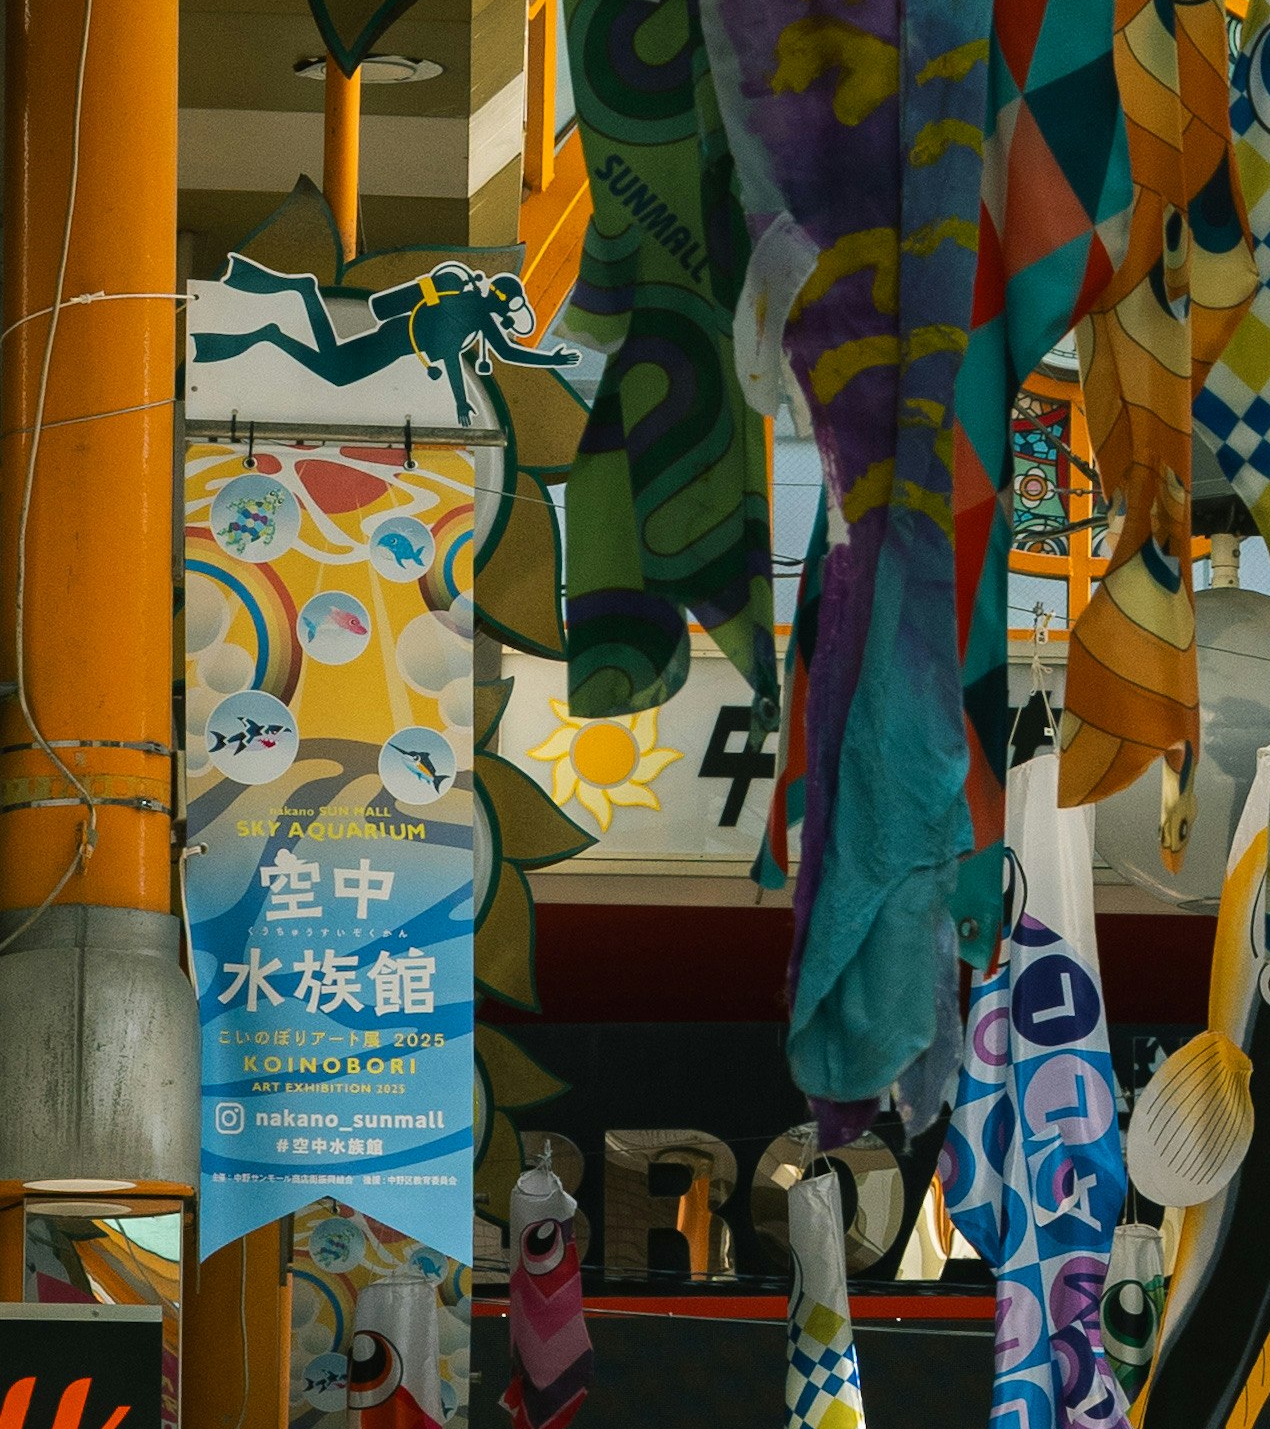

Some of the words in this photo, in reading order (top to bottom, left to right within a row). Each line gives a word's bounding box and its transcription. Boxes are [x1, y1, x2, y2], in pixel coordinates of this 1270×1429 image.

[595, 153, 709, 284] SUNMALL
[269, 806, 315, 817] nakano
[319, 806, 349, 817] SUN
[353, 806, 392, 818] MALL
[236, 820, 281, 837] SKY
[287, 821, 427, 842] AQUARIUM
[259, 849, 396, 921] 空中
[248, 927, 408, 938] くうちゅうすいぞくかん
[217, 947, 437, 1017] 水族館
[218, 1030, 381, 1048] こいのぼりアート展
[394, 1033, 446, 1048] 2025
[243, 1056, 417, 1075] KOINOBORI
[252, 1082, 280, 1093] ART
[285, 1082, 372, 1094] EXHIBITION
[376, 1084, 406, 1095] 2025
[255, 1109, 445, 1132] nakano_sunmall
[276, 1137, 384, 1156] #空中水族館
